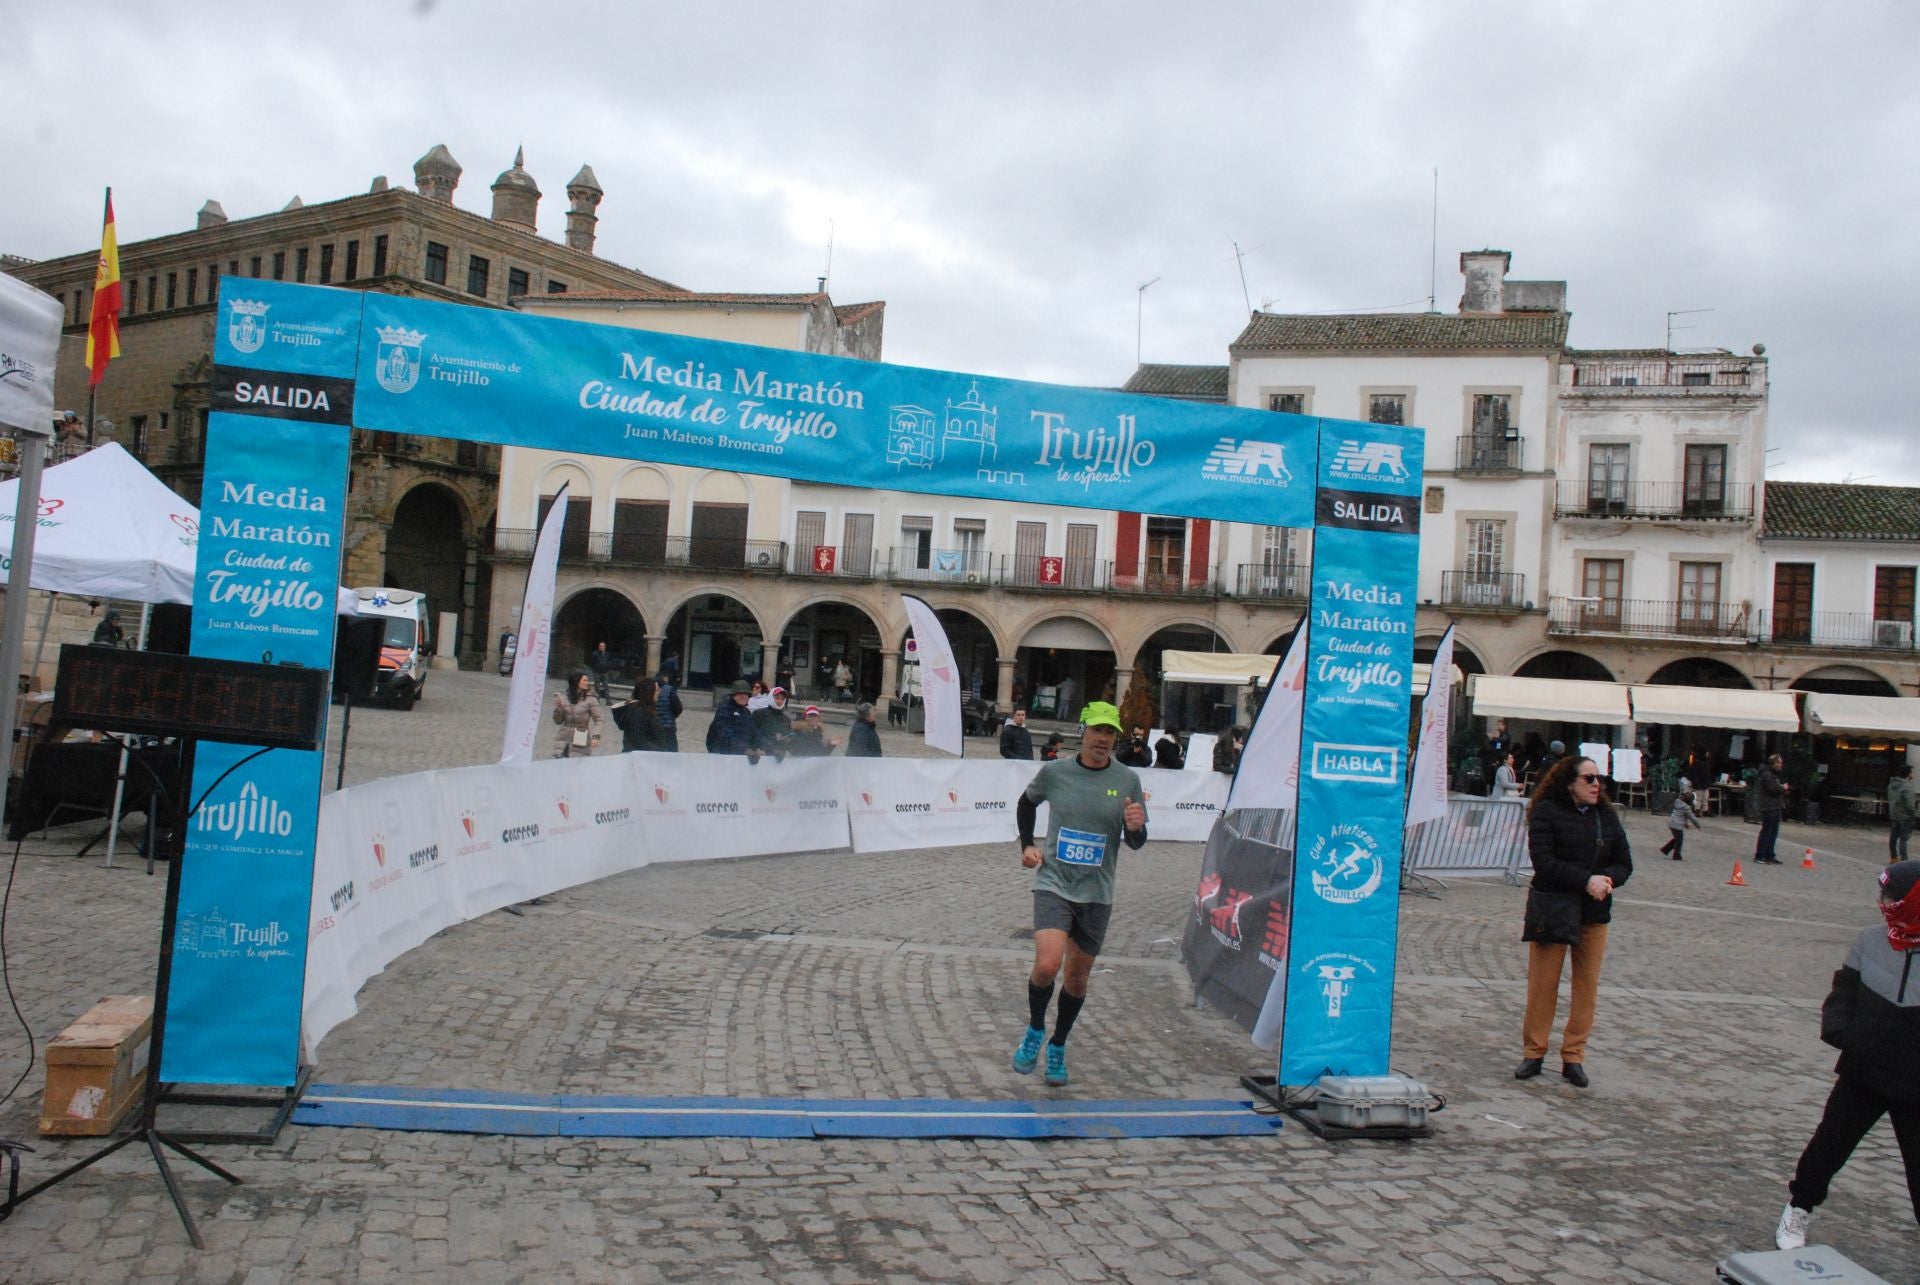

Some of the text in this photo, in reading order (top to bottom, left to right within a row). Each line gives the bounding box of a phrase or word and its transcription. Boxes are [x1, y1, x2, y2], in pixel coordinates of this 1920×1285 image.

[272, 330, 321, 348] Trujillo
[430, 352, 521, 374] Ayuntamiento de
[428, 365, 490, 387] Trujillo
[618, 352, 865, 410] Media Maratón
[234, 381, 330, 411] SALIDA
[579, 380, 838, 444] Ciudad de Trujillo
[624, 423, 784, 455] Juan Mateos Broncano
[1030, 410, 1156, 477] Trujillo
[1057, 462, 1071, 482] te
[1201, 470, 1288, 488] www.musicrun.es
[1329, 469, 1405, 485] www.musicrun.es
[220, 480, 327, 513] Media
[1333, 500, 1404, 523] SALIDA
[210, 516, 332, 548] Maratón
[223, 549, 314, 573] Ciudad de
[207, 570, 324, 618] Trujillo
[1325, 580, 1403, 606] Media
[208, 618, 319, 636] Juan Mateos Broncano
[1319, 610, 1408, 634] Maratón
[1328, 636, 1392, 656] Ciudad de
[1316, 655, 1402, 693] Trujillo
[1324, 754, 1384, 773] HABLA
[197, 781, 292, 841] trujillo
[1065, 844, 1095, 860] 586
[1310, 823, 1378, 860] Club Atletismo
[229, 921, 289, 947] Trujillo
[1331, 996, 1339, 1010] S
